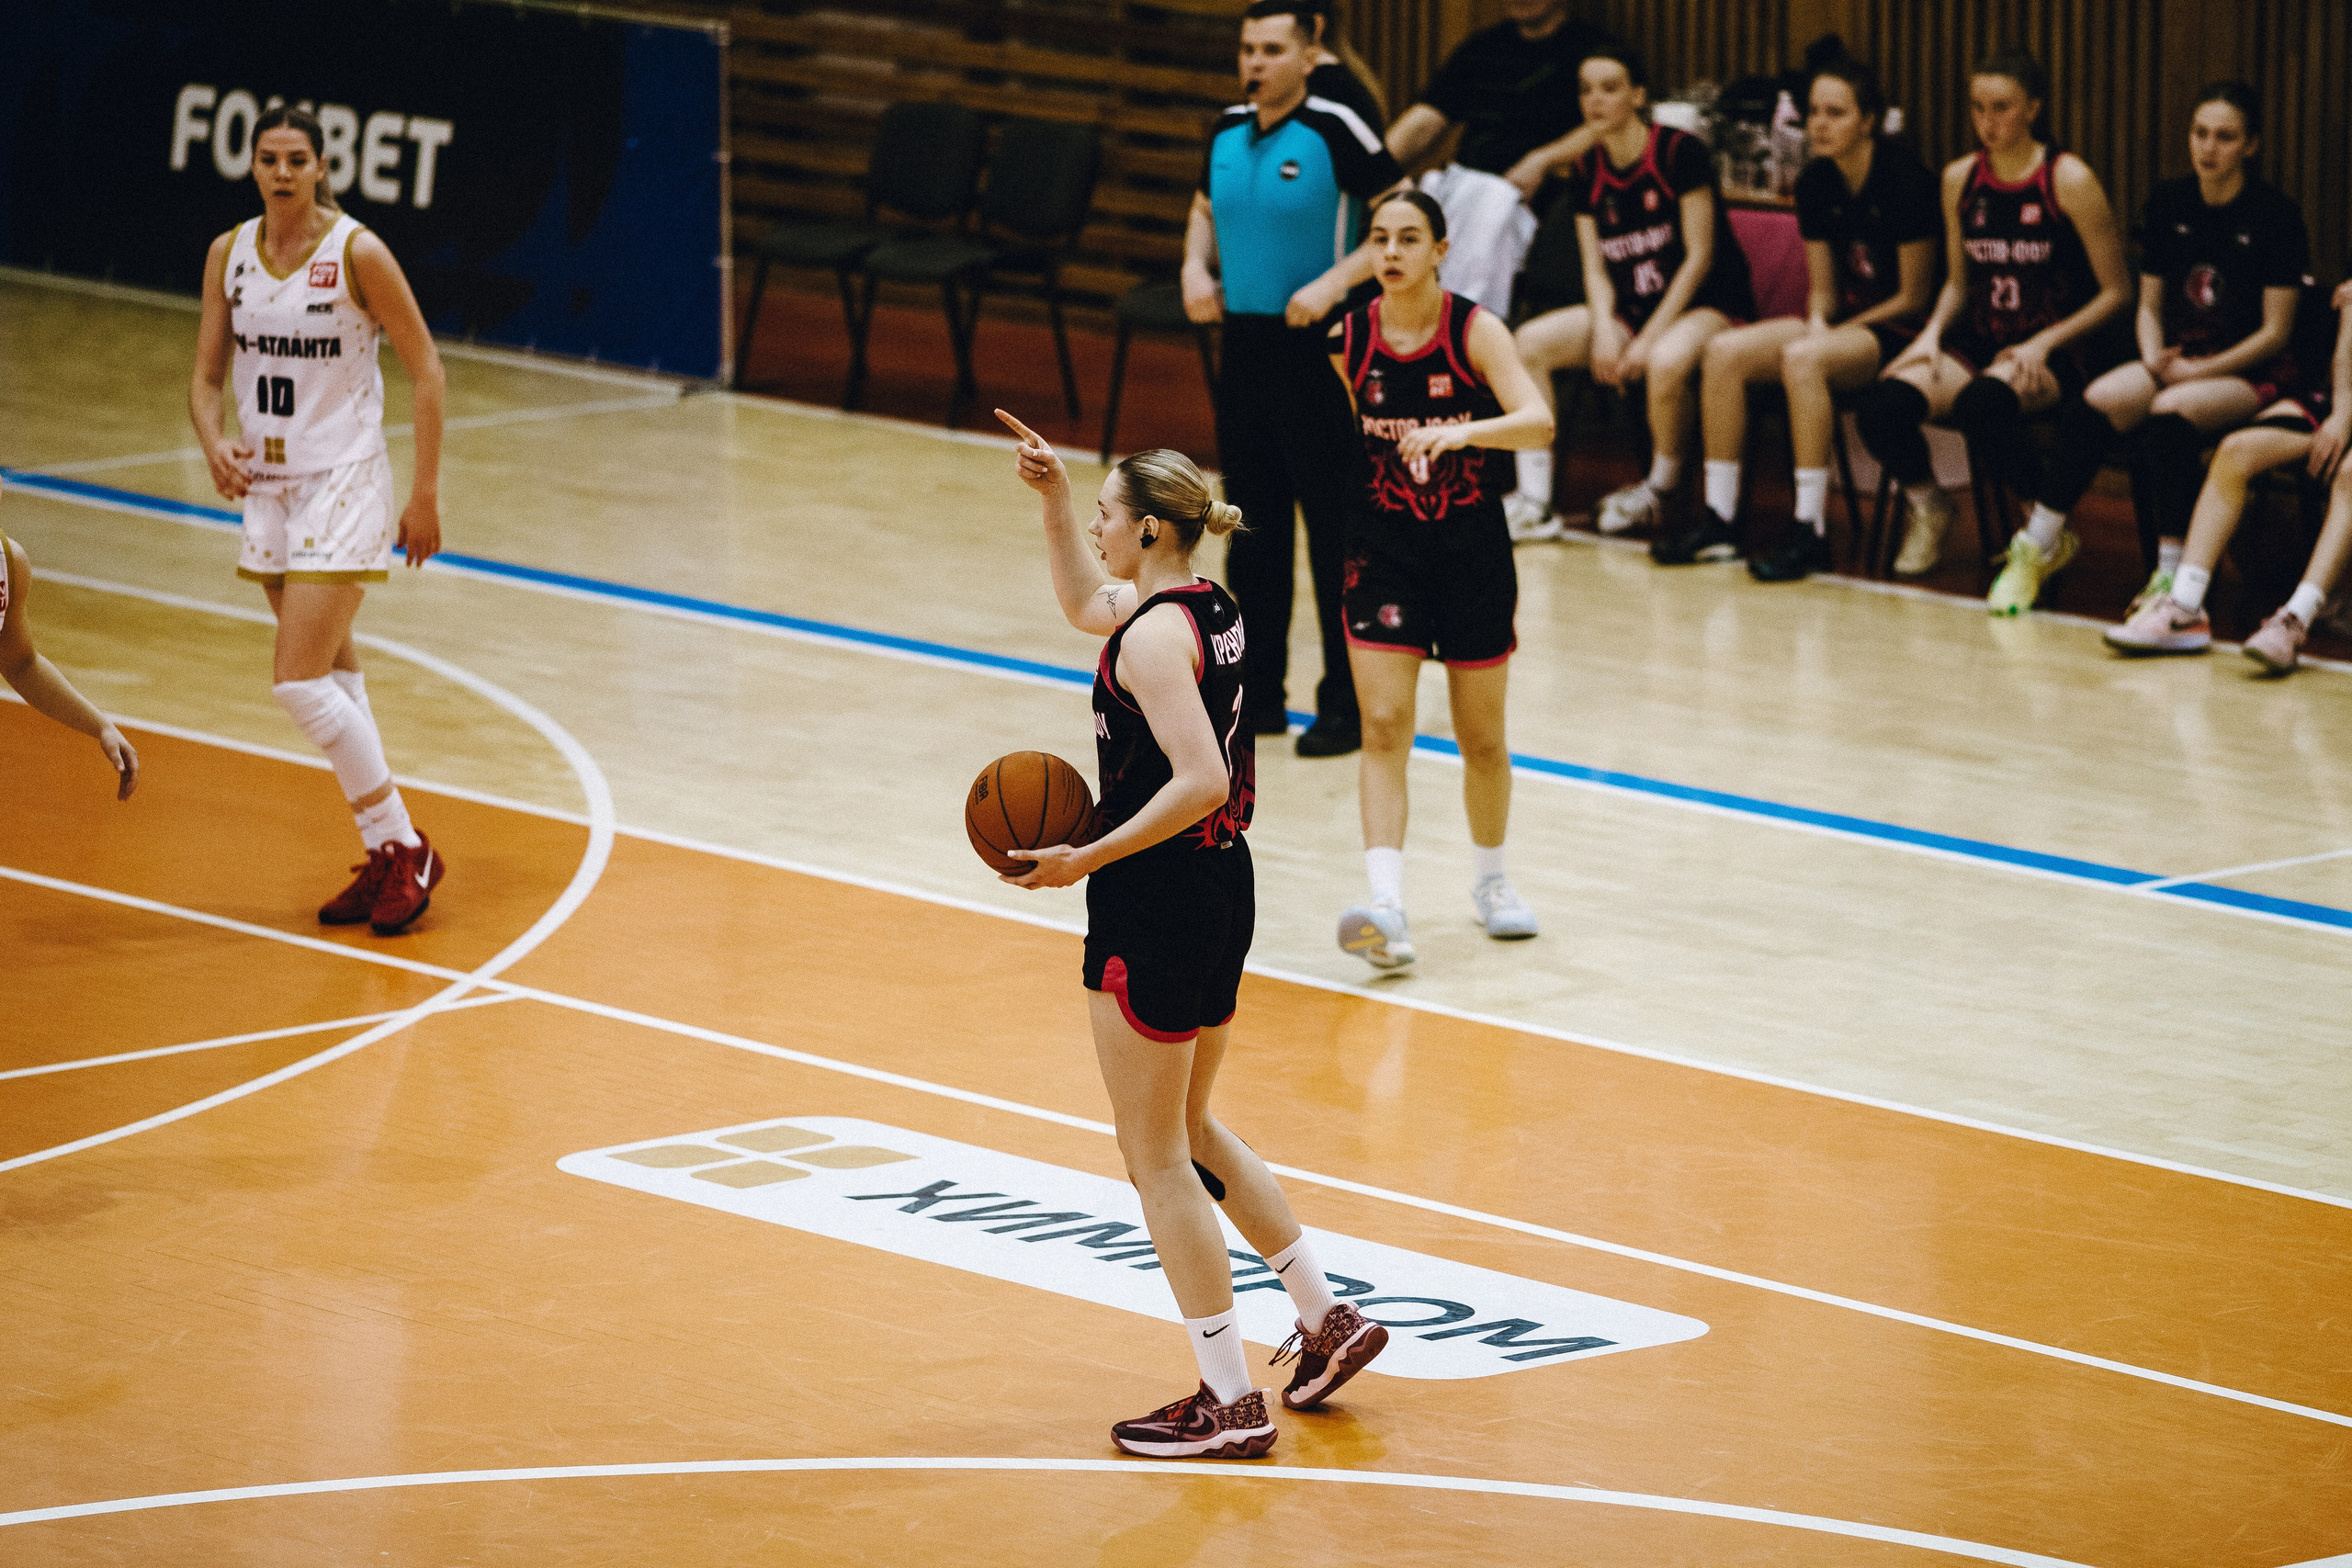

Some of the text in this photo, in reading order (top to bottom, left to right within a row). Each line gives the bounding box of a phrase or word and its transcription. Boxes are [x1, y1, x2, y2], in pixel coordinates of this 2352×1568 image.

[169, 84, 454, 210] FOBET
[1991, 275, 2020, 310] 23
[258, 375, 294, 417] 10
[978, 775, 989, 802] FIBA
